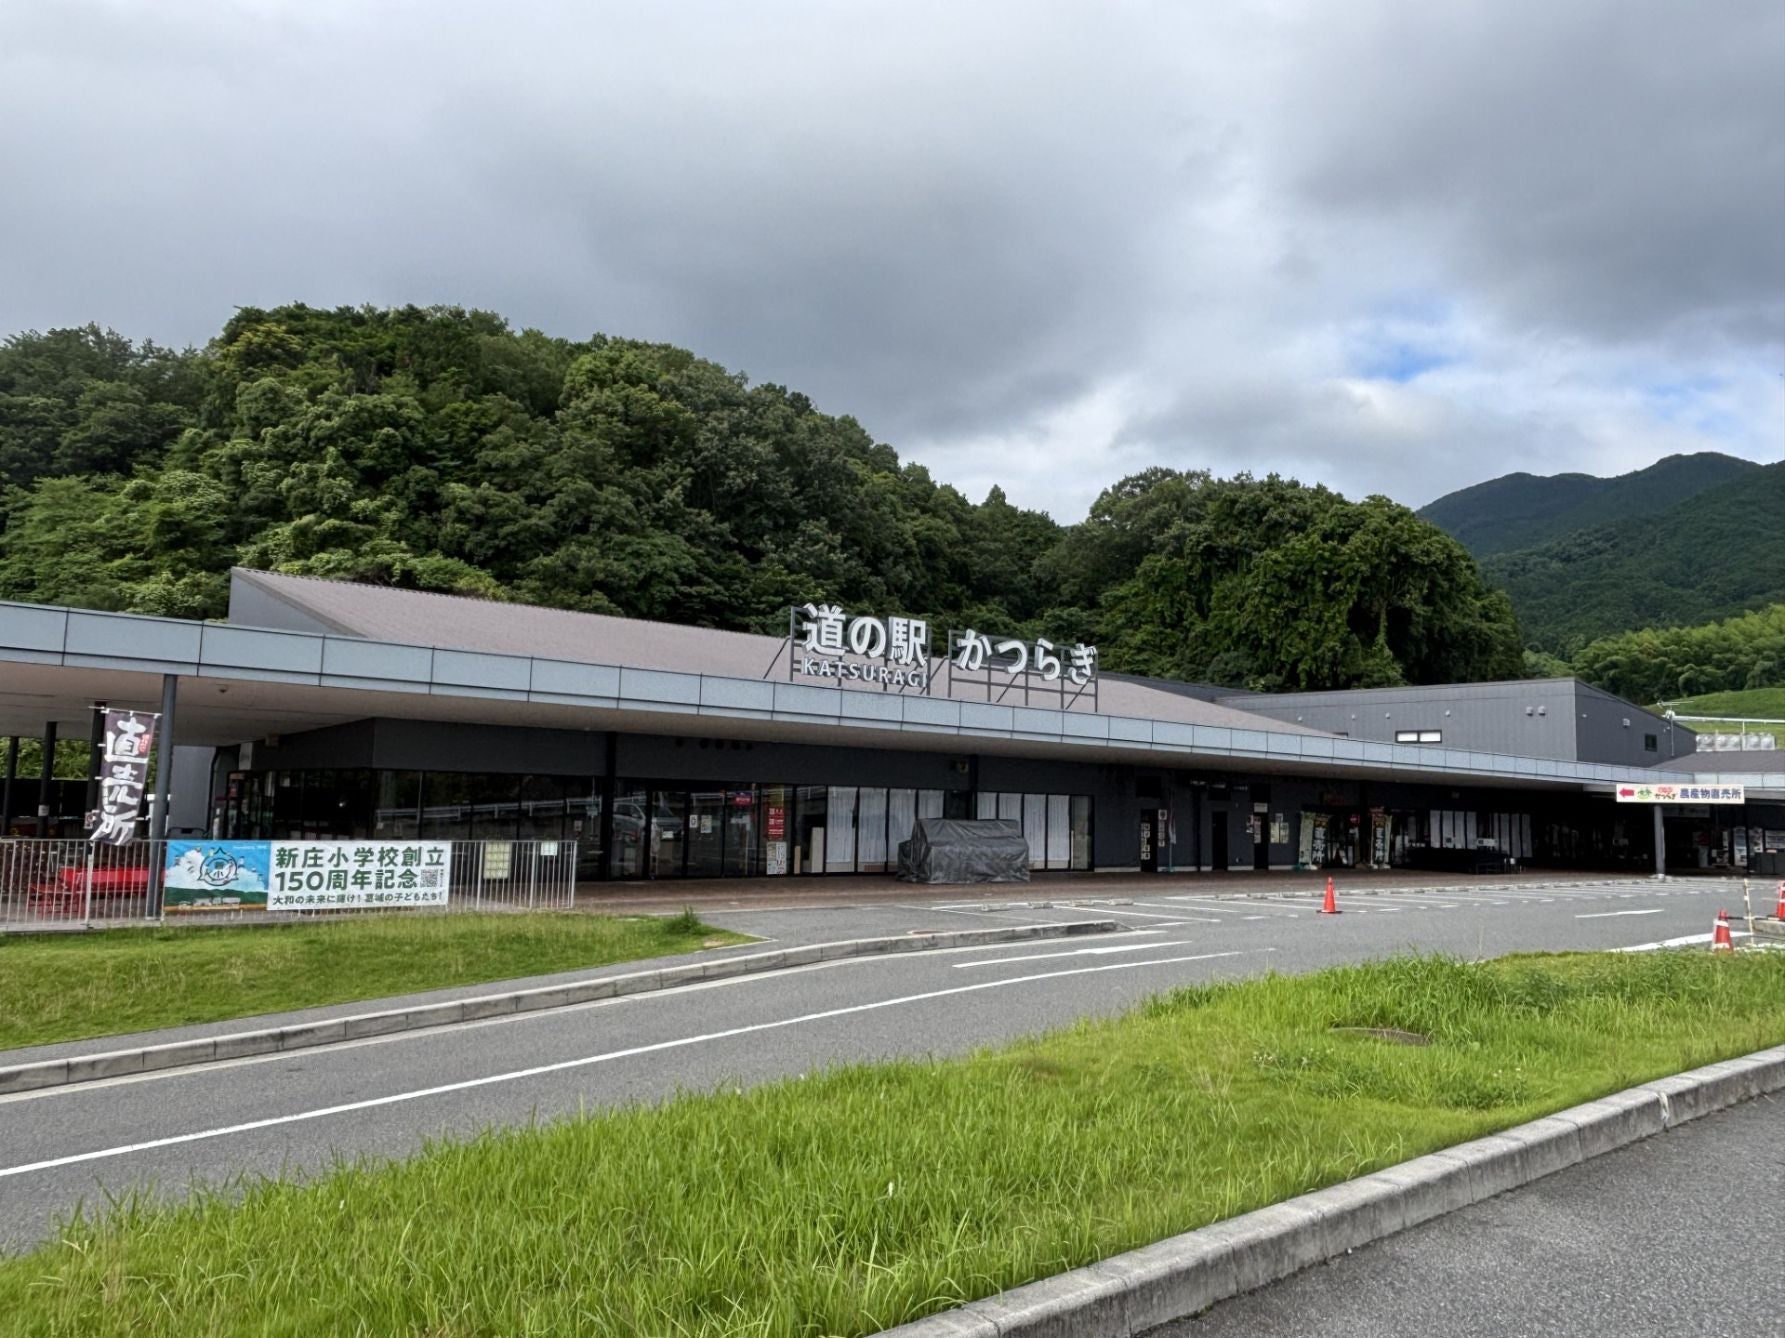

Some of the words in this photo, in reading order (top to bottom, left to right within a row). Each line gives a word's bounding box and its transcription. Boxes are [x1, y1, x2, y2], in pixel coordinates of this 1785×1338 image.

[802, 602, 927, 667] 道の駅
[957, 628, 1097, 685] かつらぎ
[802, 657, 928, 688] KATSURAGI
[90, 717, 148, 845] 直売所
[275, 846, 445, 869] 新庄小学校創立
[275, 868, 418, 892] 150周年記念
